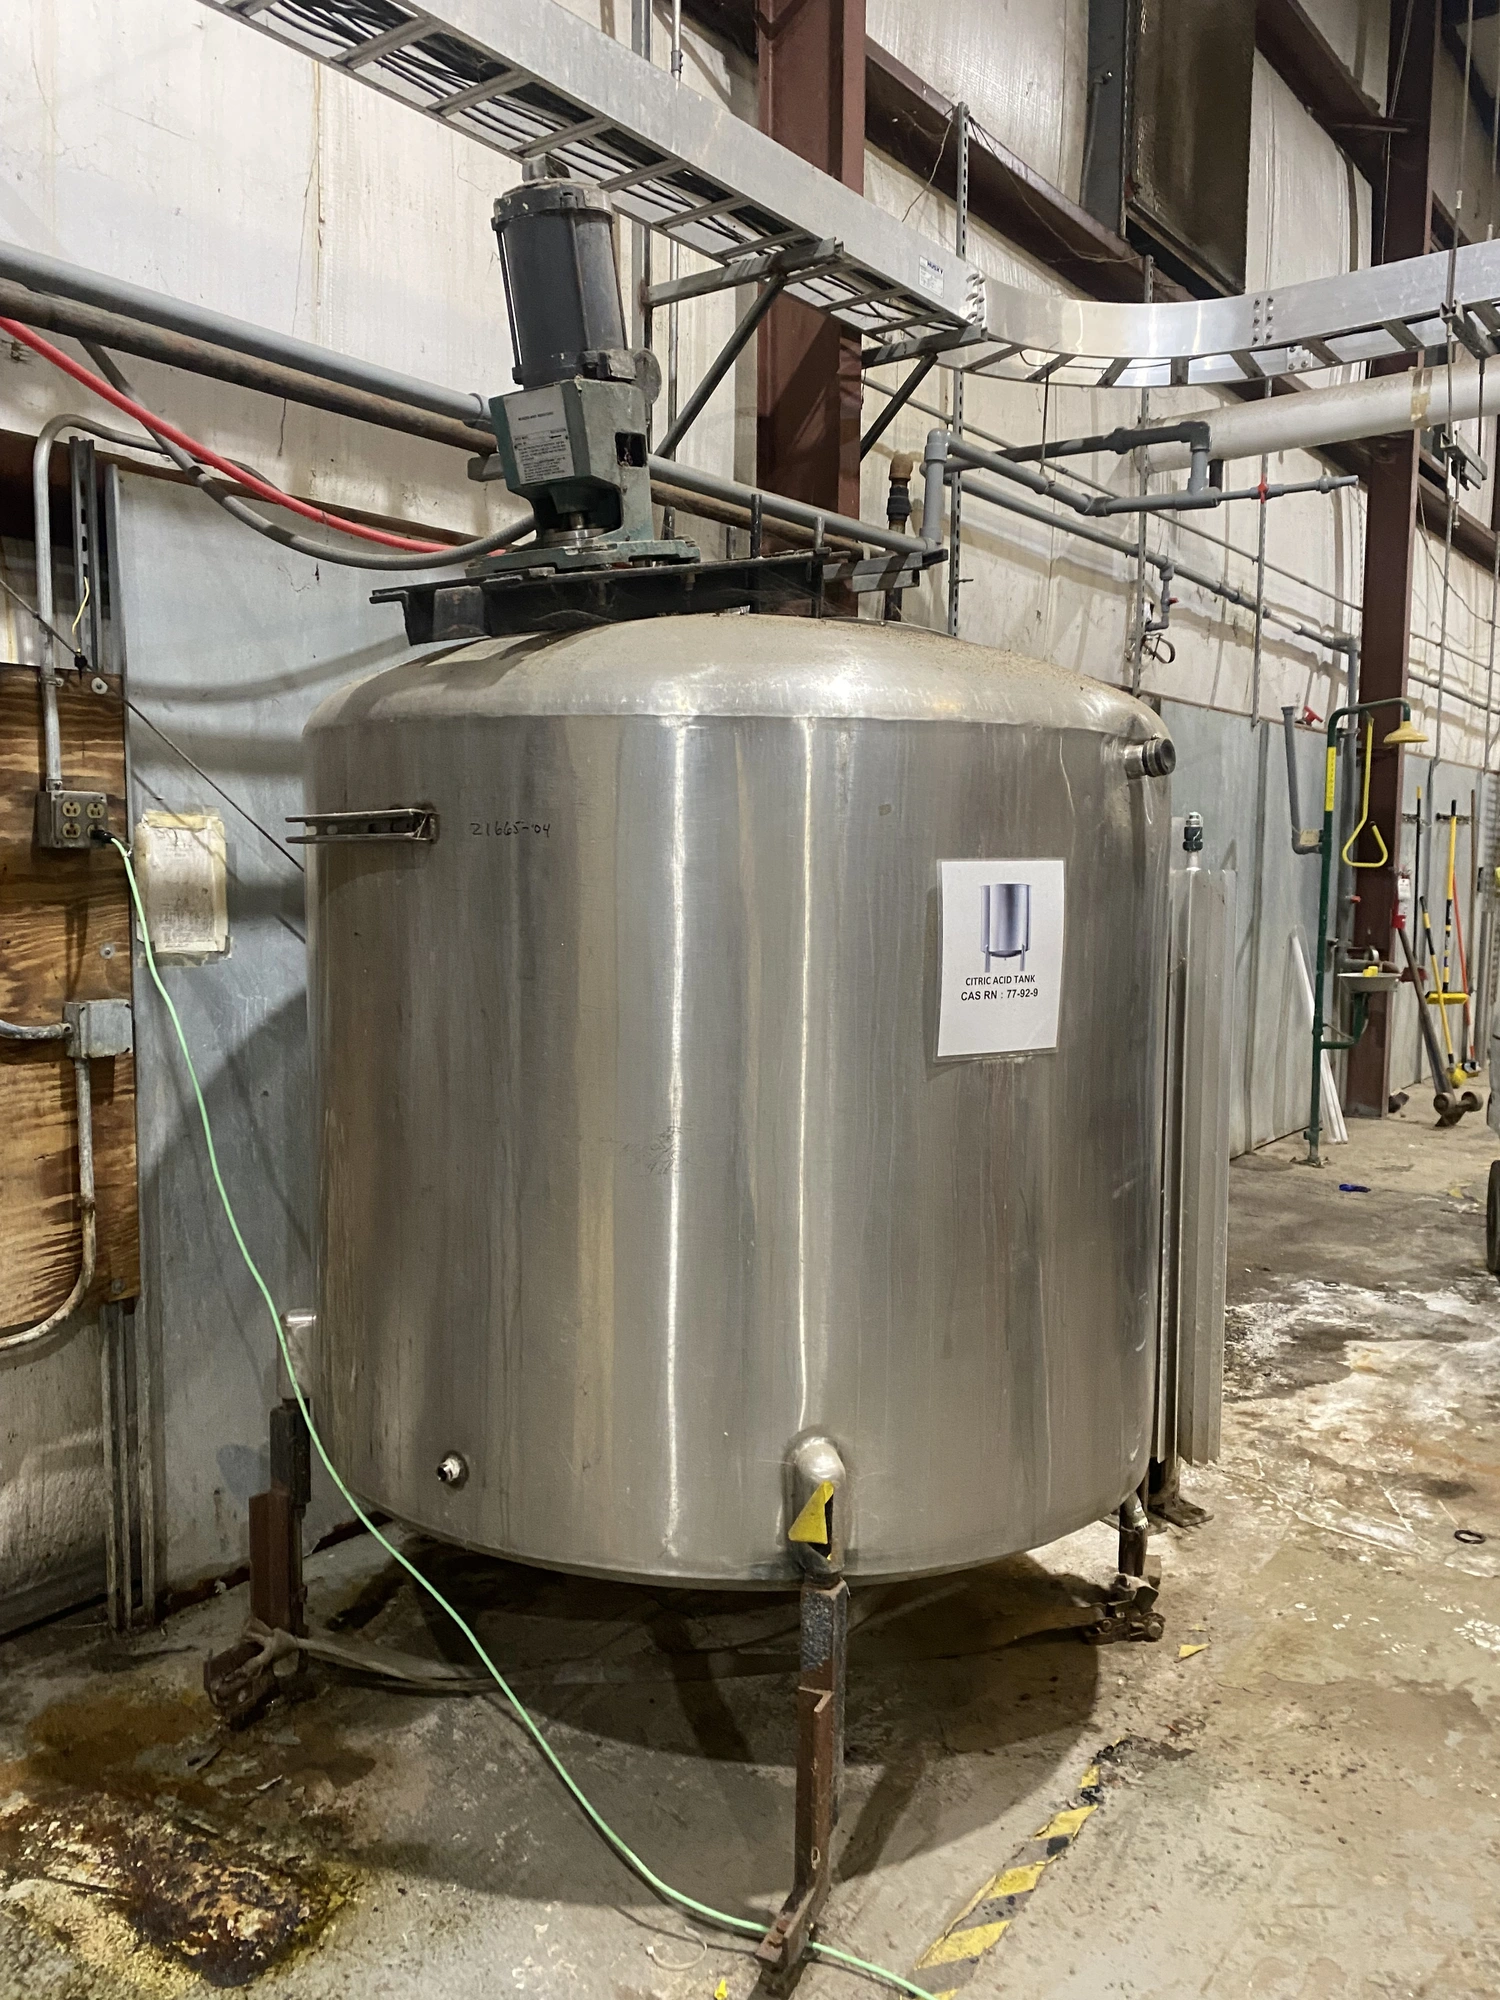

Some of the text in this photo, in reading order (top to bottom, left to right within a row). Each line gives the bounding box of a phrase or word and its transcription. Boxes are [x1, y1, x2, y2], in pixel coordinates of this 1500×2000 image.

[965, 974, 1035, 986] CITRIC ACID TANK
[961, 991, 981, 1001] CAS
[984, 990, 998, 999] RN
[1007, 988, 1038, 999] 77-92-9
